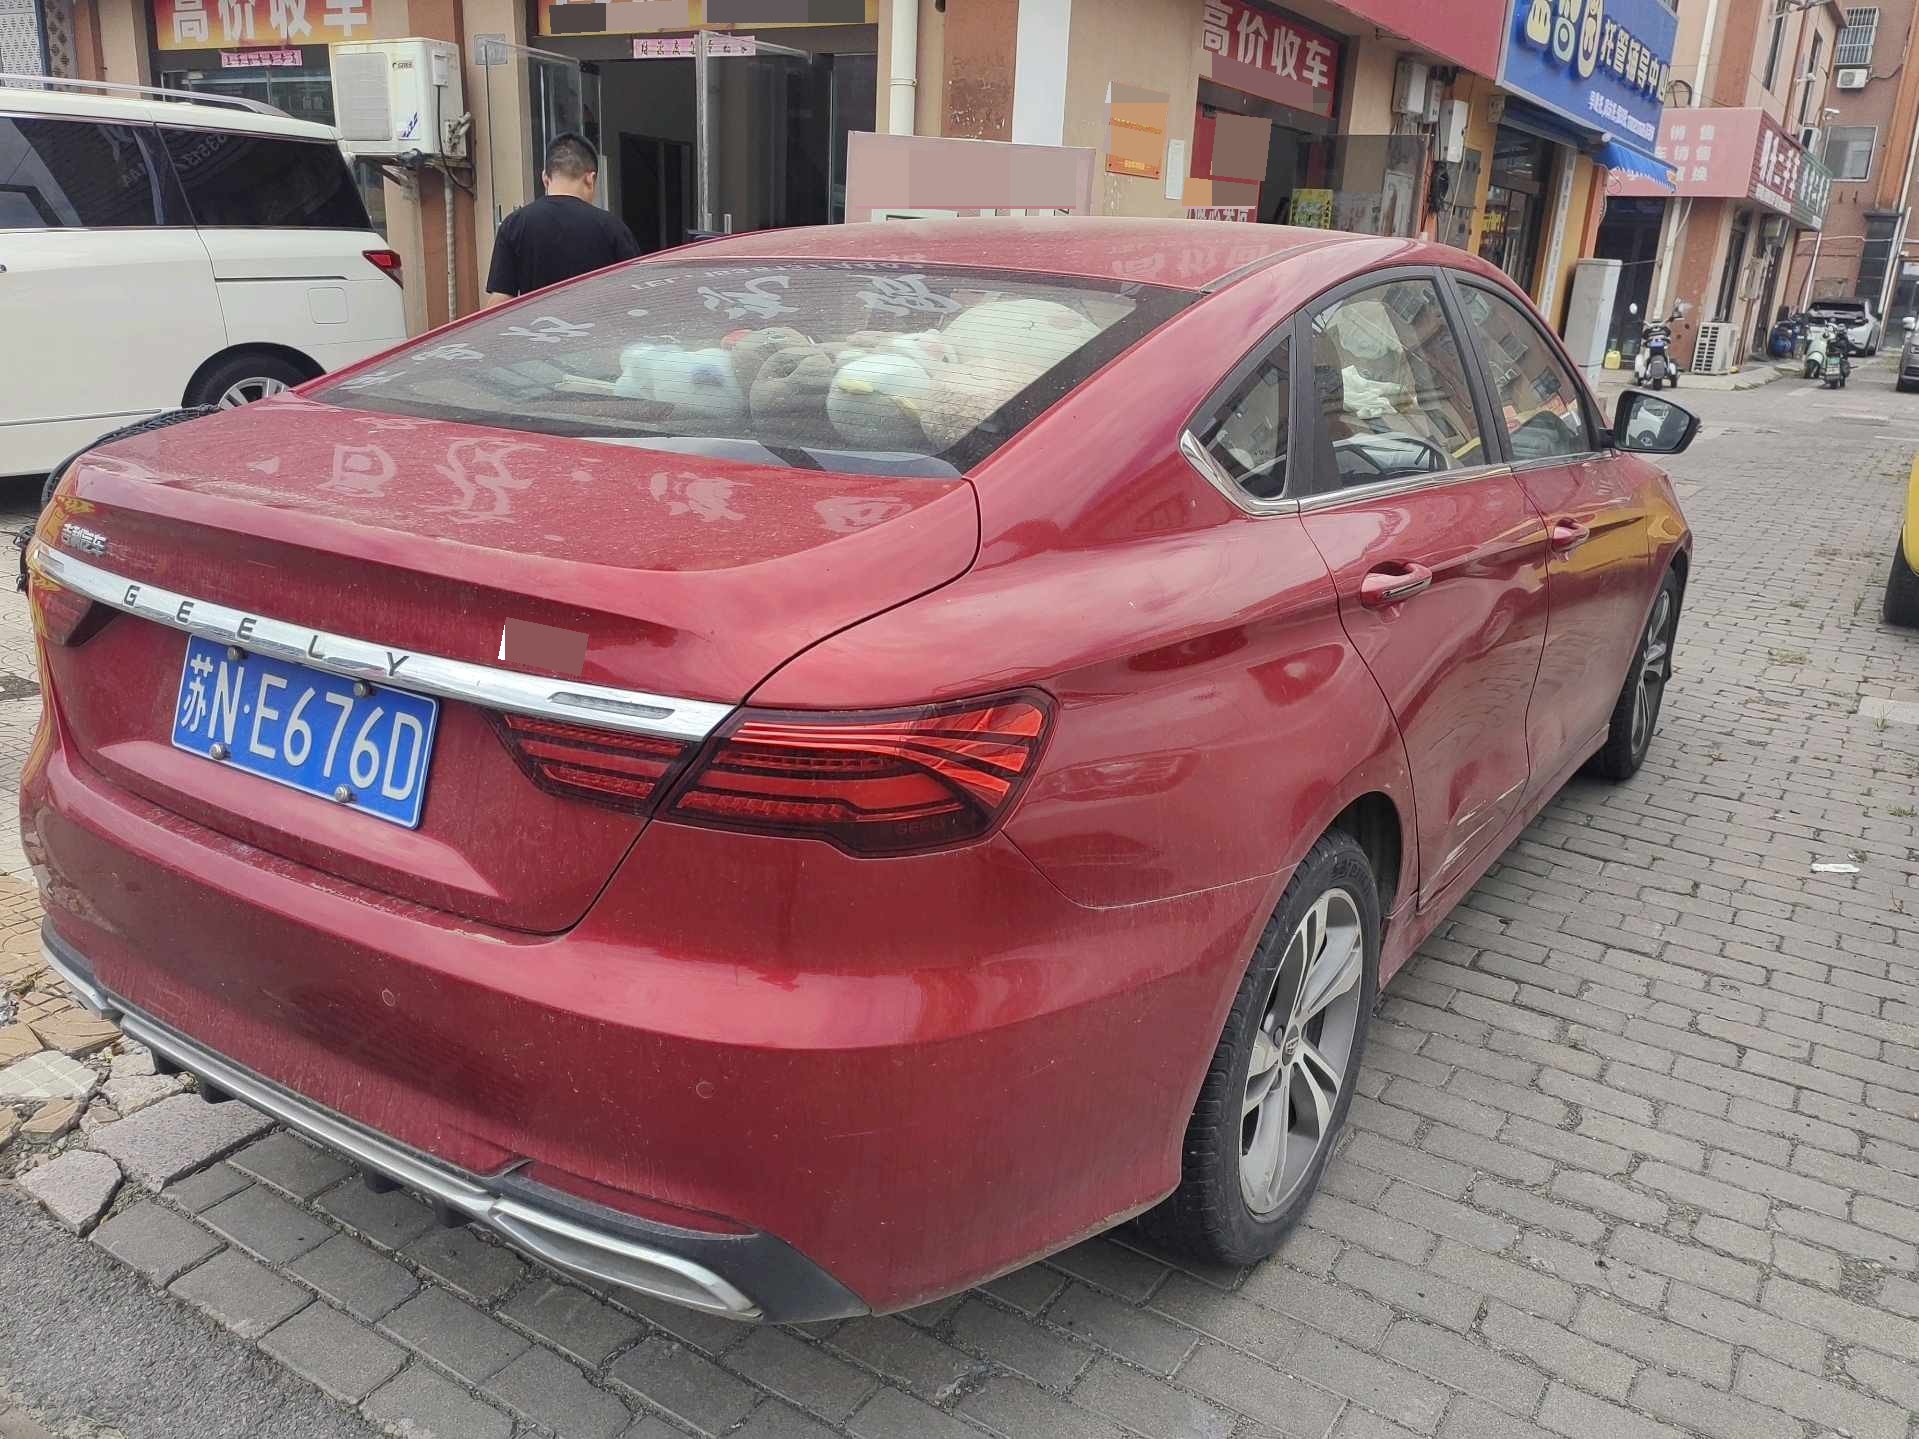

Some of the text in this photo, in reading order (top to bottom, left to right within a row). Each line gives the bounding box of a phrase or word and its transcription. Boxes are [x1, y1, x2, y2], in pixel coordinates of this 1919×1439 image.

[173, 0, 367, 43] 高价收车
[1201, 0, 1330, 87] 高价收车
[123, 584, 409, 677] GEELY
[180, 653, 423, 801] 苏N·E676D
